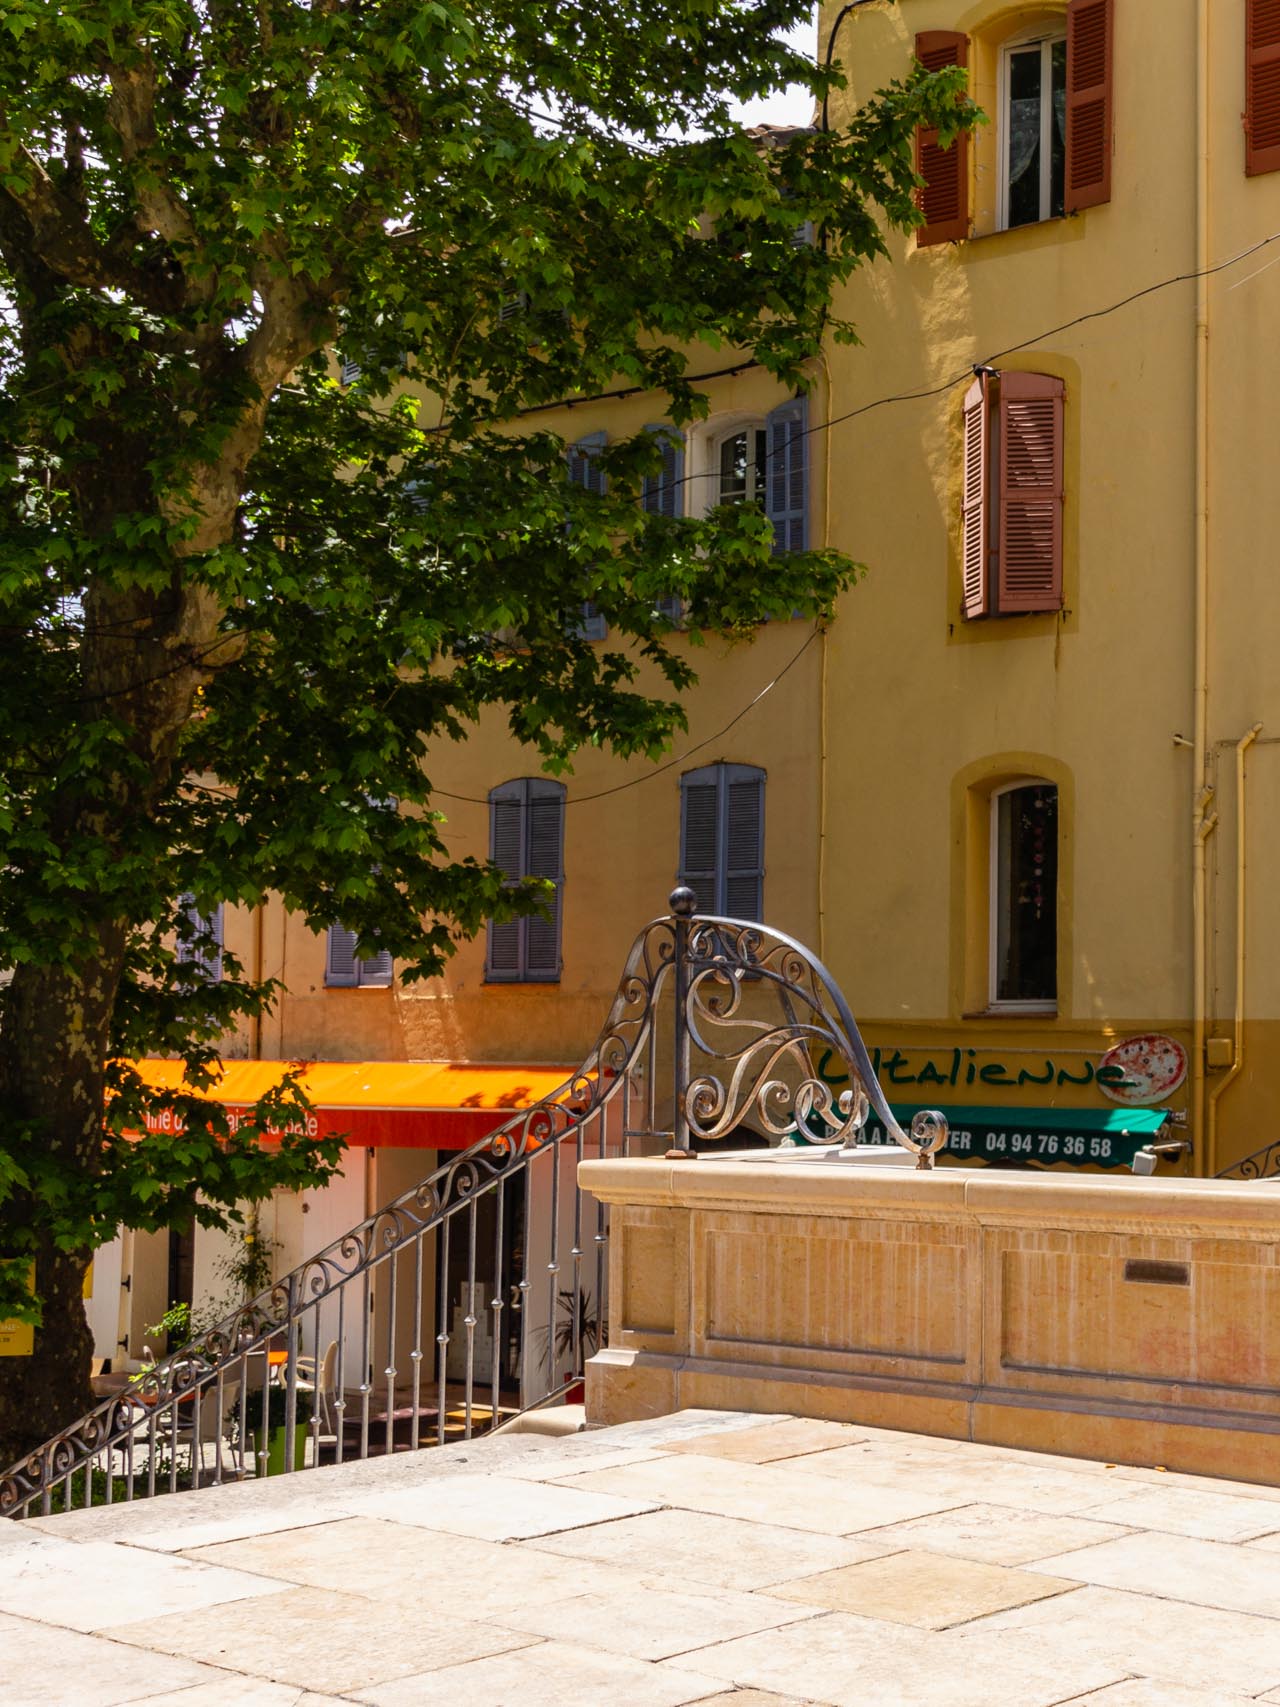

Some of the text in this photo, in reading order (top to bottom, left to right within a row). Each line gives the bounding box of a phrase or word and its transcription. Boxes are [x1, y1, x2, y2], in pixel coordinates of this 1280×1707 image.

[818, 1047, 1139, 1089] LItalienne
[986, 1134, 1006, 1152] 04
[1011, 1135, 1032, 1153] 94
[1037, 1136, 1059, 1154] 76
[1064, 1137, 1085, 1155] 36
[1090, 1138, 1112, 1157] 58
